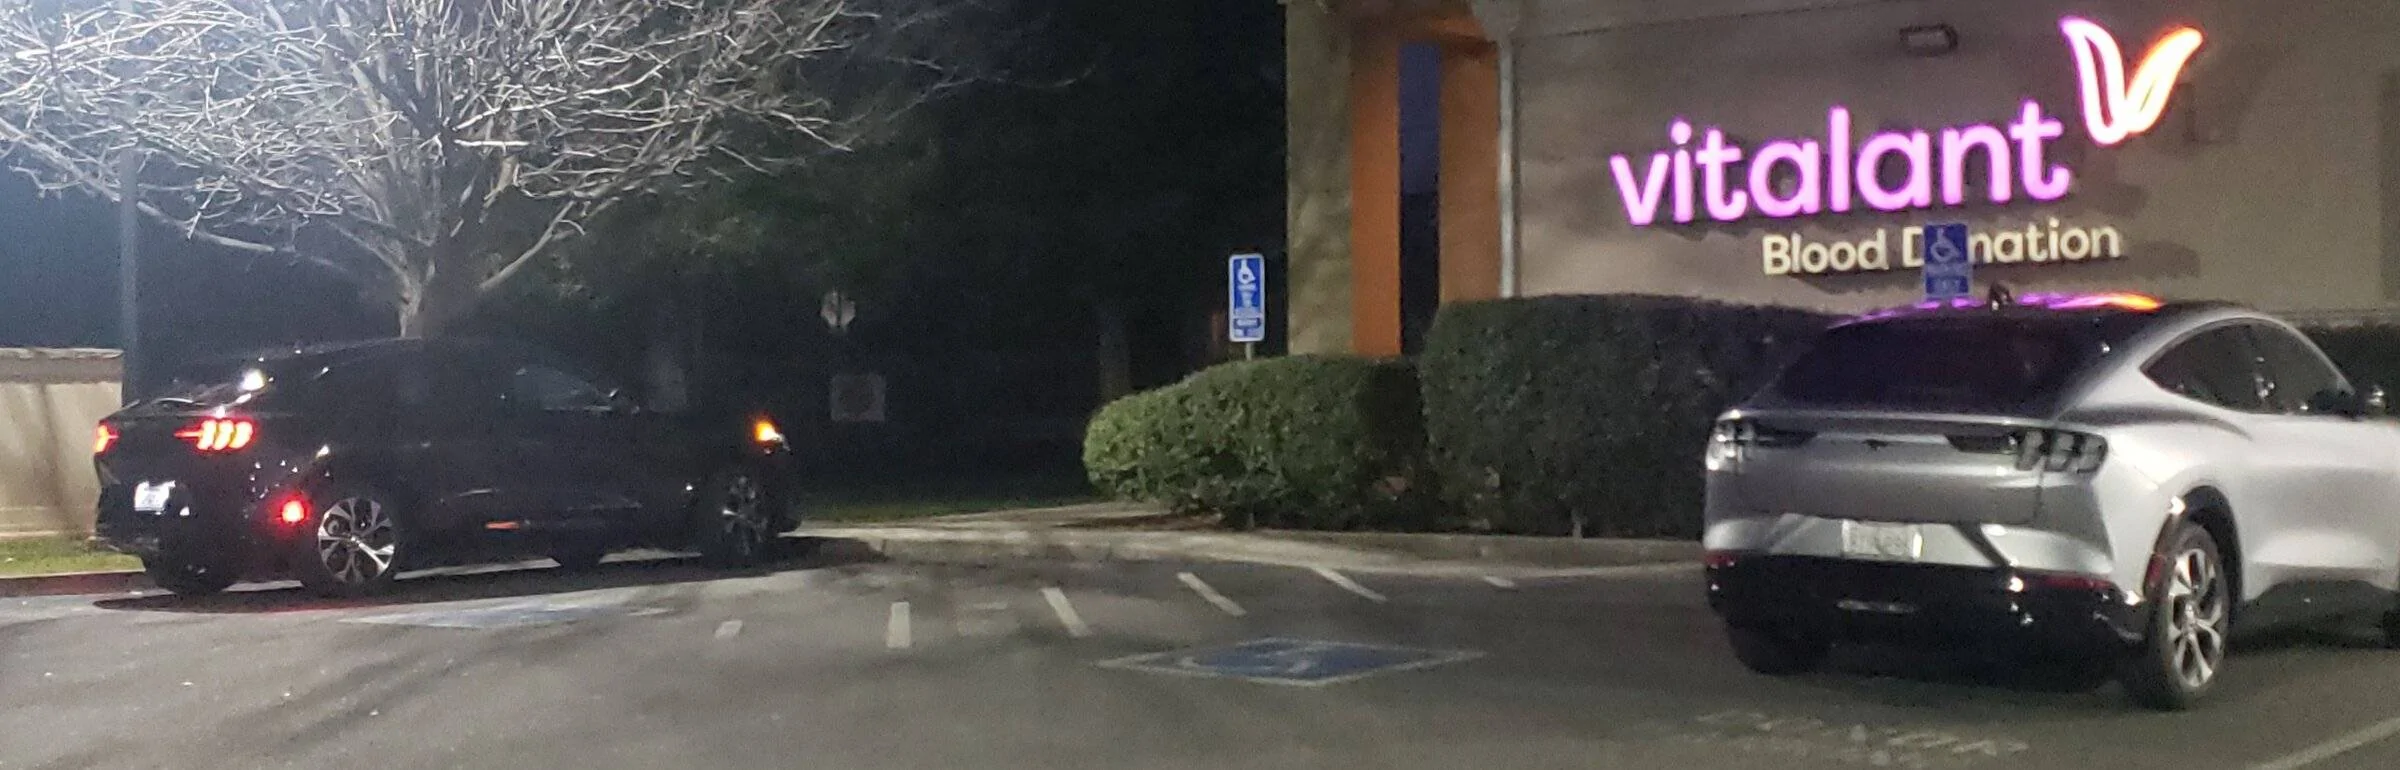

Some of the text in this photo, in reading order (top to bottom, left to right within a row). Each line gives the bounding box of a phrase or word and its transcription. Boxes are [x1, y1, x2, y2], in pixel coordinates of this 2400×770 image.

[1609, 99, 2071, 226] vitalant
[1763, 216, 2122, 275] Blood Dnation
